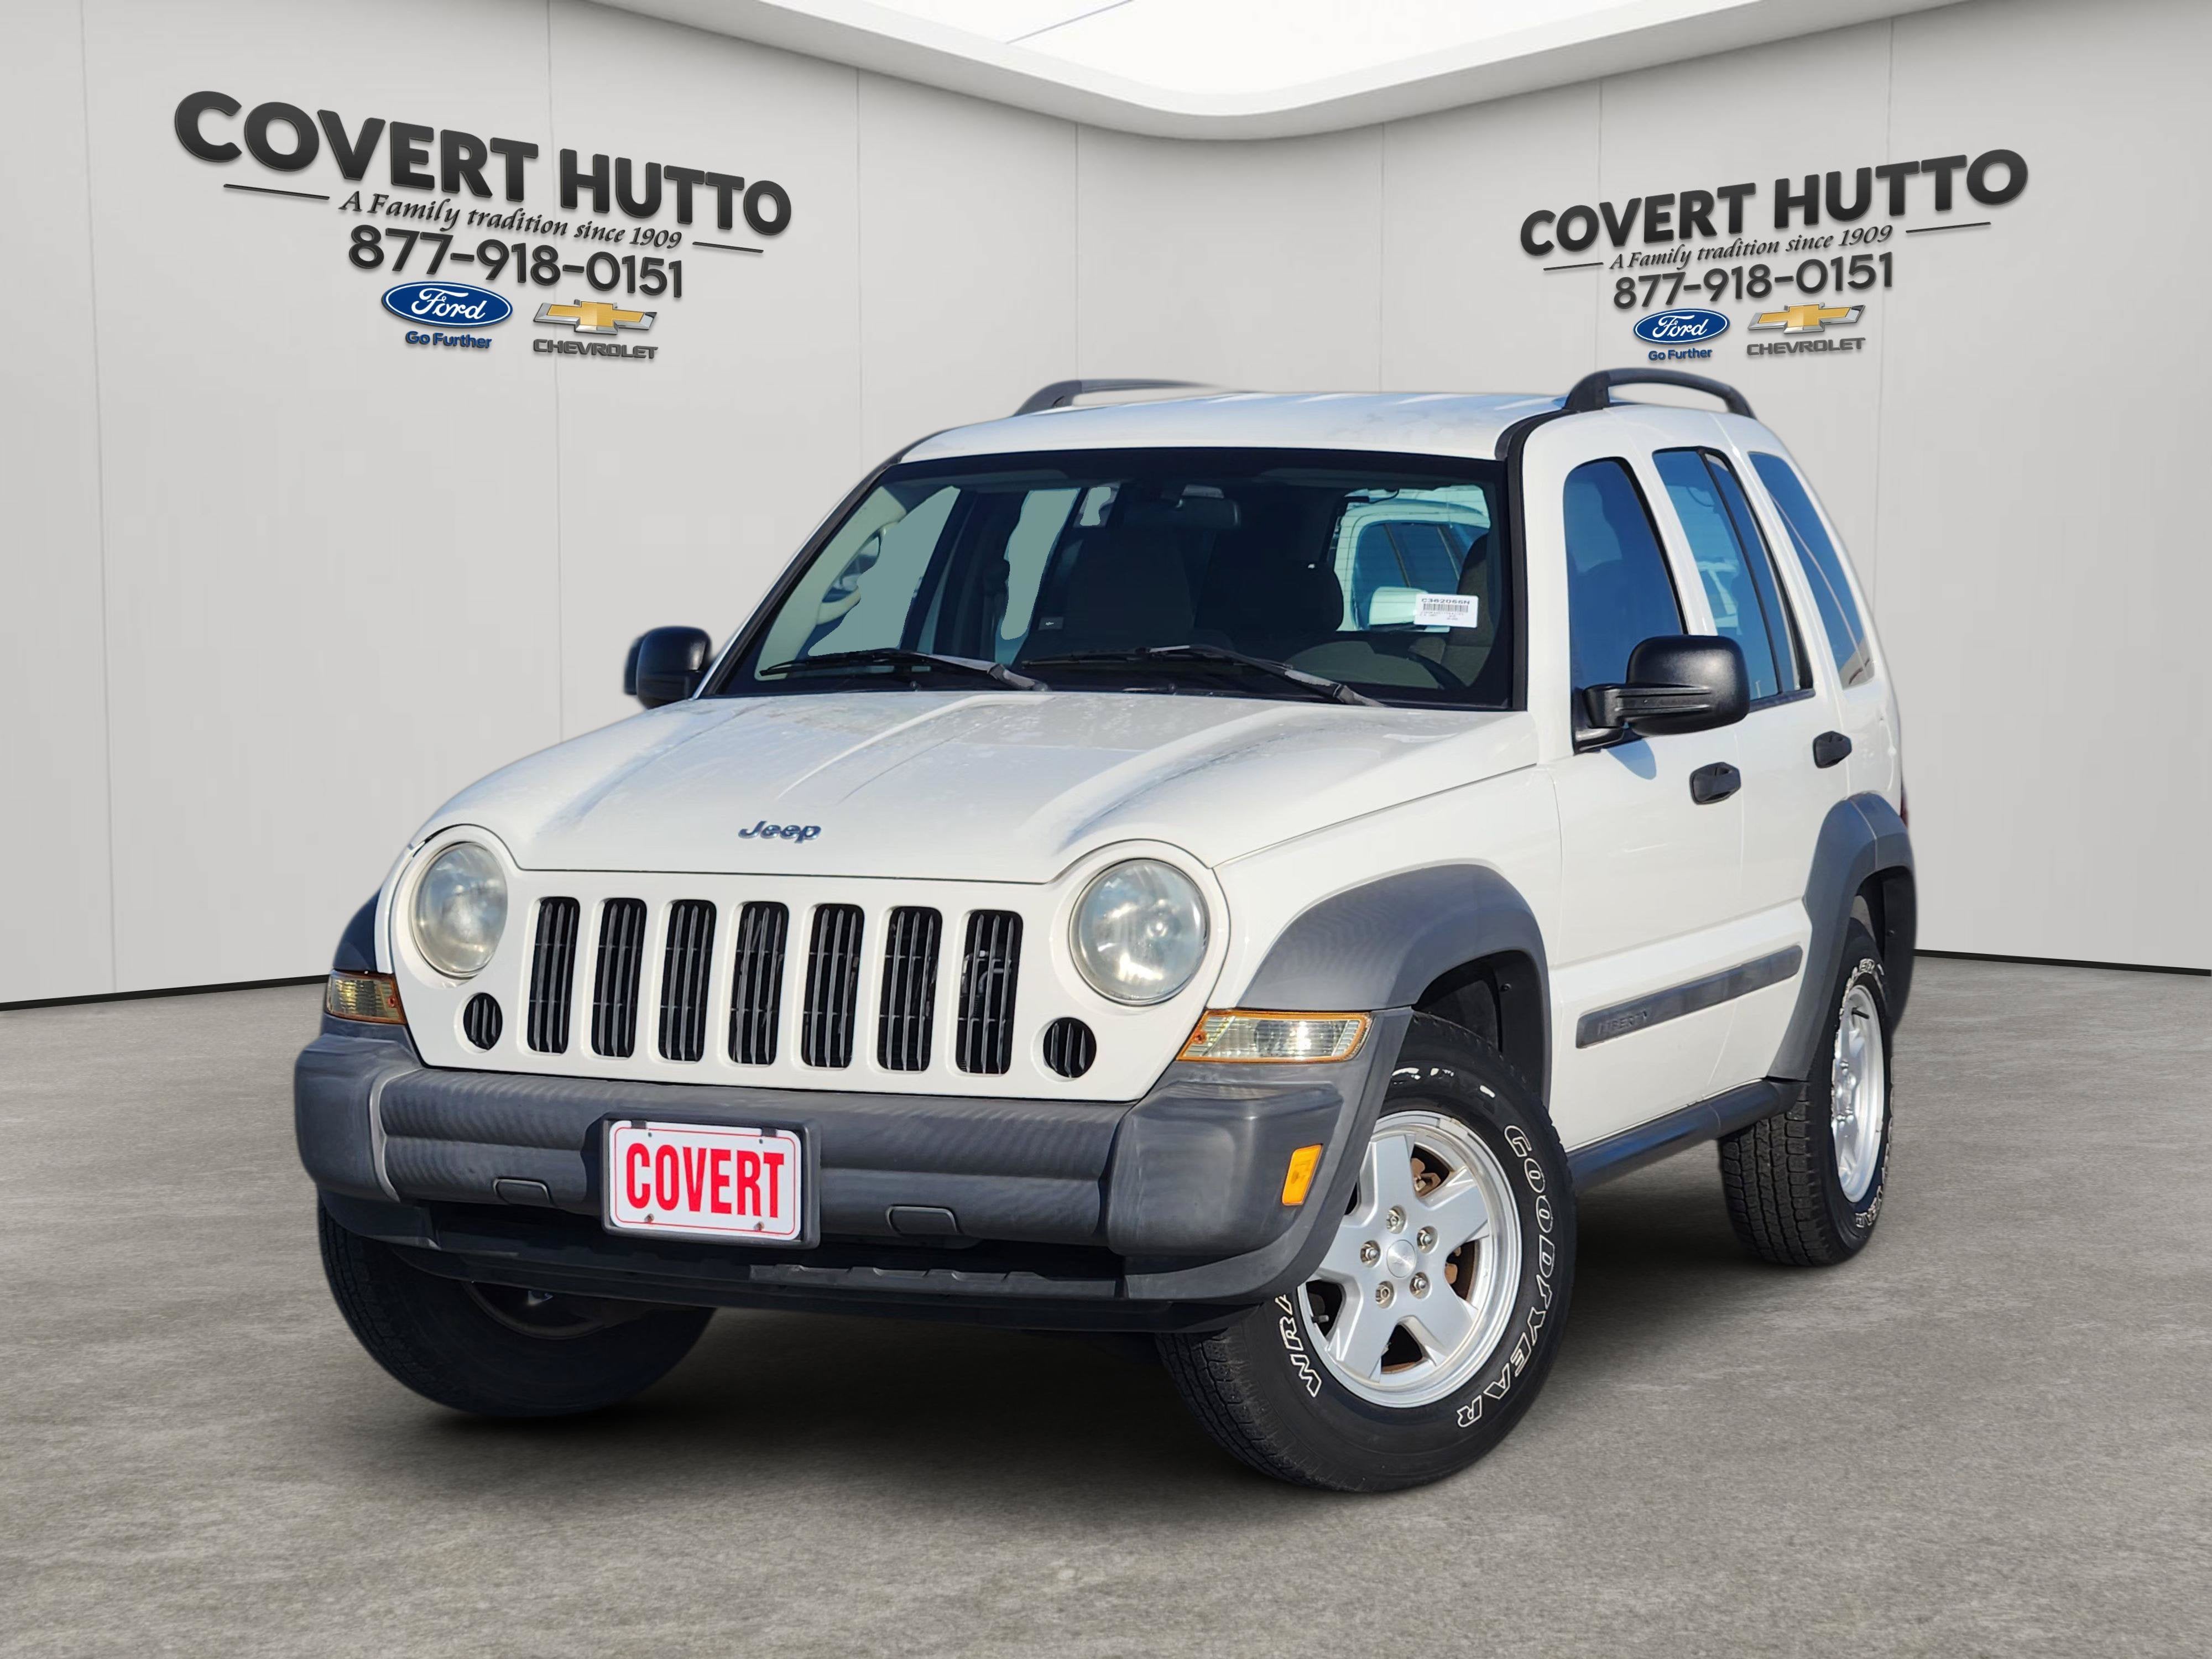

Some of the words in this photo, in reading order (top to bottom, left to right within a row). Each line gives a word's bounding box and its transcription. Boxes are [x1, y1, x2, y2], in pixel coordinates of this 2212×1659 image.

[175, 91, 539, 202] COVERT
[560, 148, 792, 236] HUTTO
[338, 190, 363, 212] A
[367, 192, 461, 232] Family
[467, 207, 568, 237] tradition
[573, 221, 625, 242] since
[629, 227, 682, 249] 1909
[1520, 182, 1756, 256] COVERT
[1774, 149, 2028, 229] HUTTO
[348, 225, 682, 298] 877-918-0151
[1609, 253, 1624, 270] A
[1626, 244, 1692, 270] Family
[1697, 238, 1780, 262] tradition
[1785, 234, 1834, 253] since
[1838, 225, 1893, 247] 1909
[1613, 251, 1893, 310] 877-918-0151
[410, 288, 487, 321] Ford
[1652, 315, 1708, 338] Ford
[405, 331, 431, 346] Go
[433, 332, 492, 349] Further
[533, 338, 659, 359] CHEVROLET
[1648, 350, 1666, 361] Go
[1667, 347, 1713, 360] Further
[1746, 337, 1866, 356] CHEVROLET
[738, 821, 822, 844] Jeep
[626, 1142, 784, 1218] COVERT
[1457, 1125, 1556, 1428] GOODYEAR
